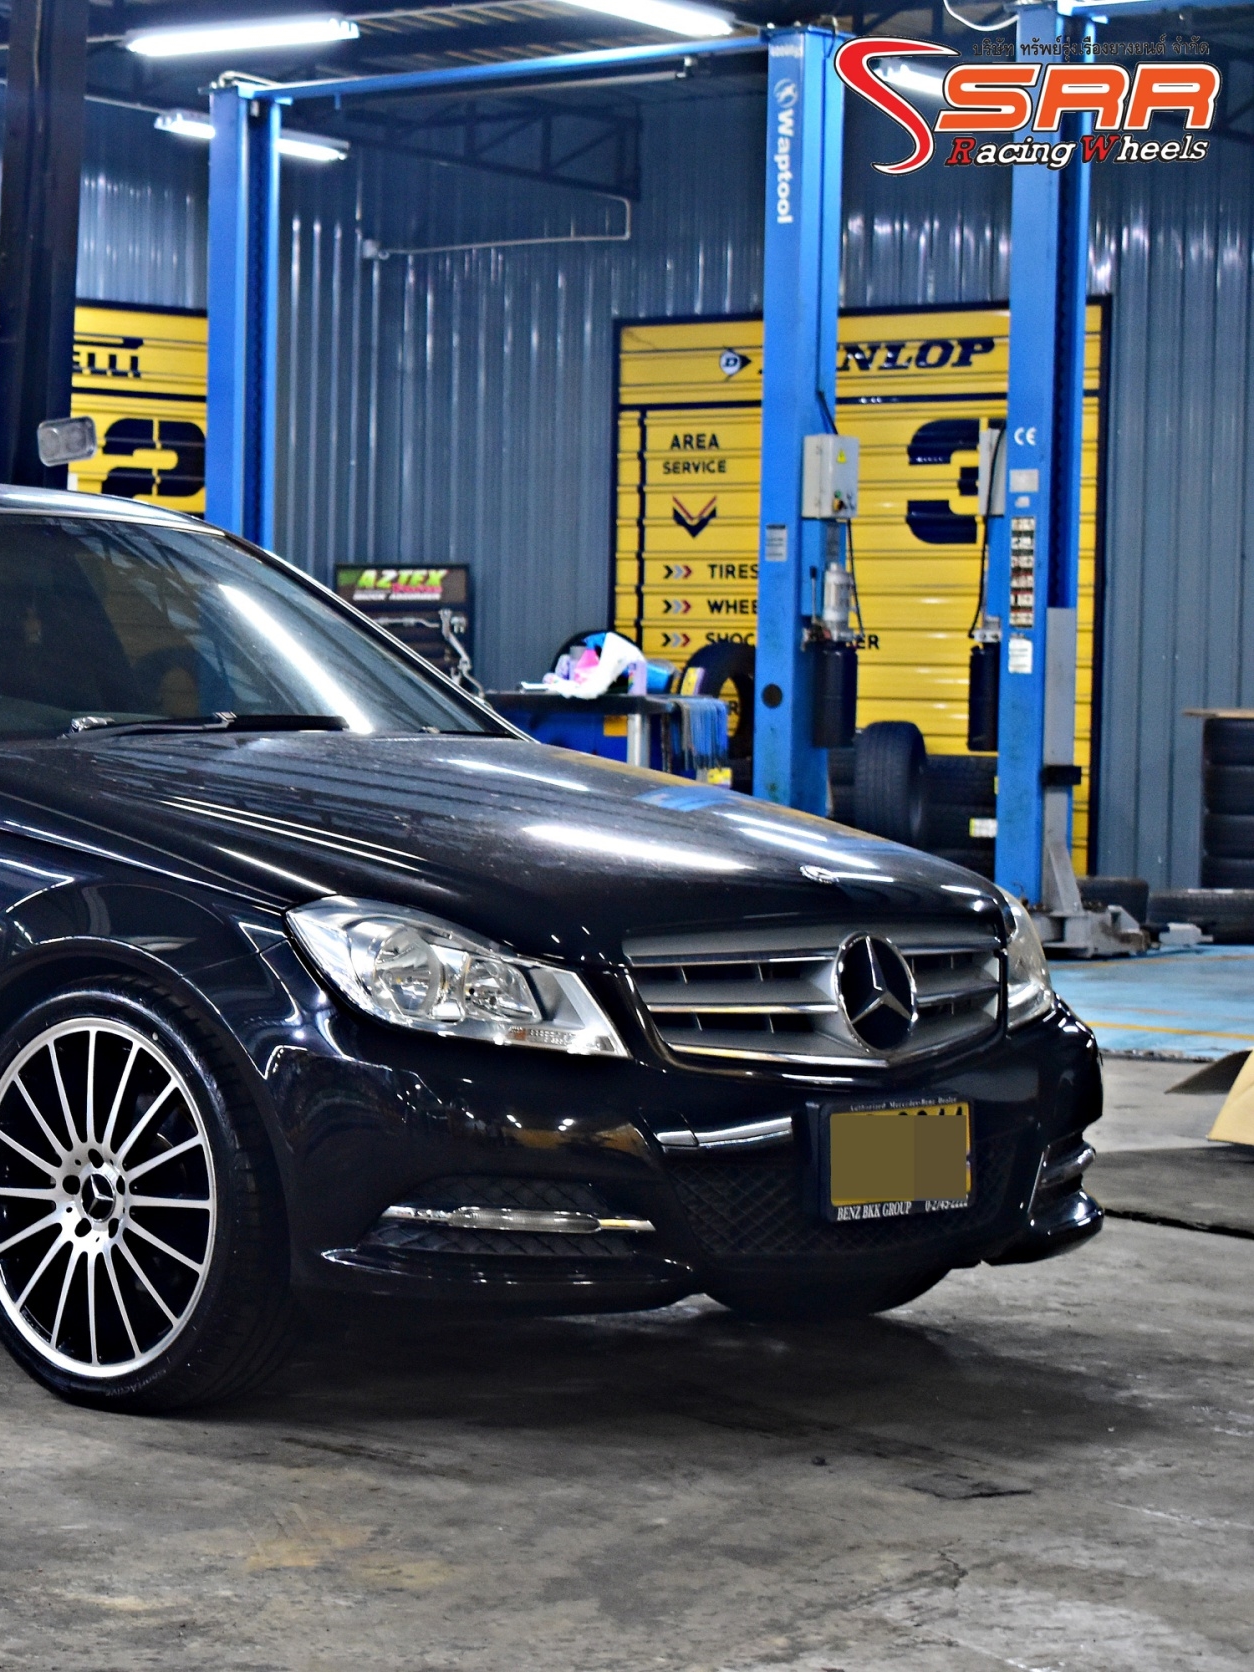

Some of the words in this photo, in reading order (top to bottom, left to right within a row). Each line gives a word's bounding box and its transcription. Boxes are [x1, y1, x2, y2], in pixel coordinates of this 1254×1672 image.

[774, 108, 794, 224] Waptool
[836, 337, 995, 371] NLOP
[670, 432, 719, 450] AREA
[1014, 427, 1037, 446] CE
[662, 458, 727, 475] SERVICE
[358, 568, 448, 588] AZTEX
[836, 1205, 861, 1221] BENZ
[862, 1203, 881, 1218] BKK
[882, 1200, 912, 1217] GROUP
